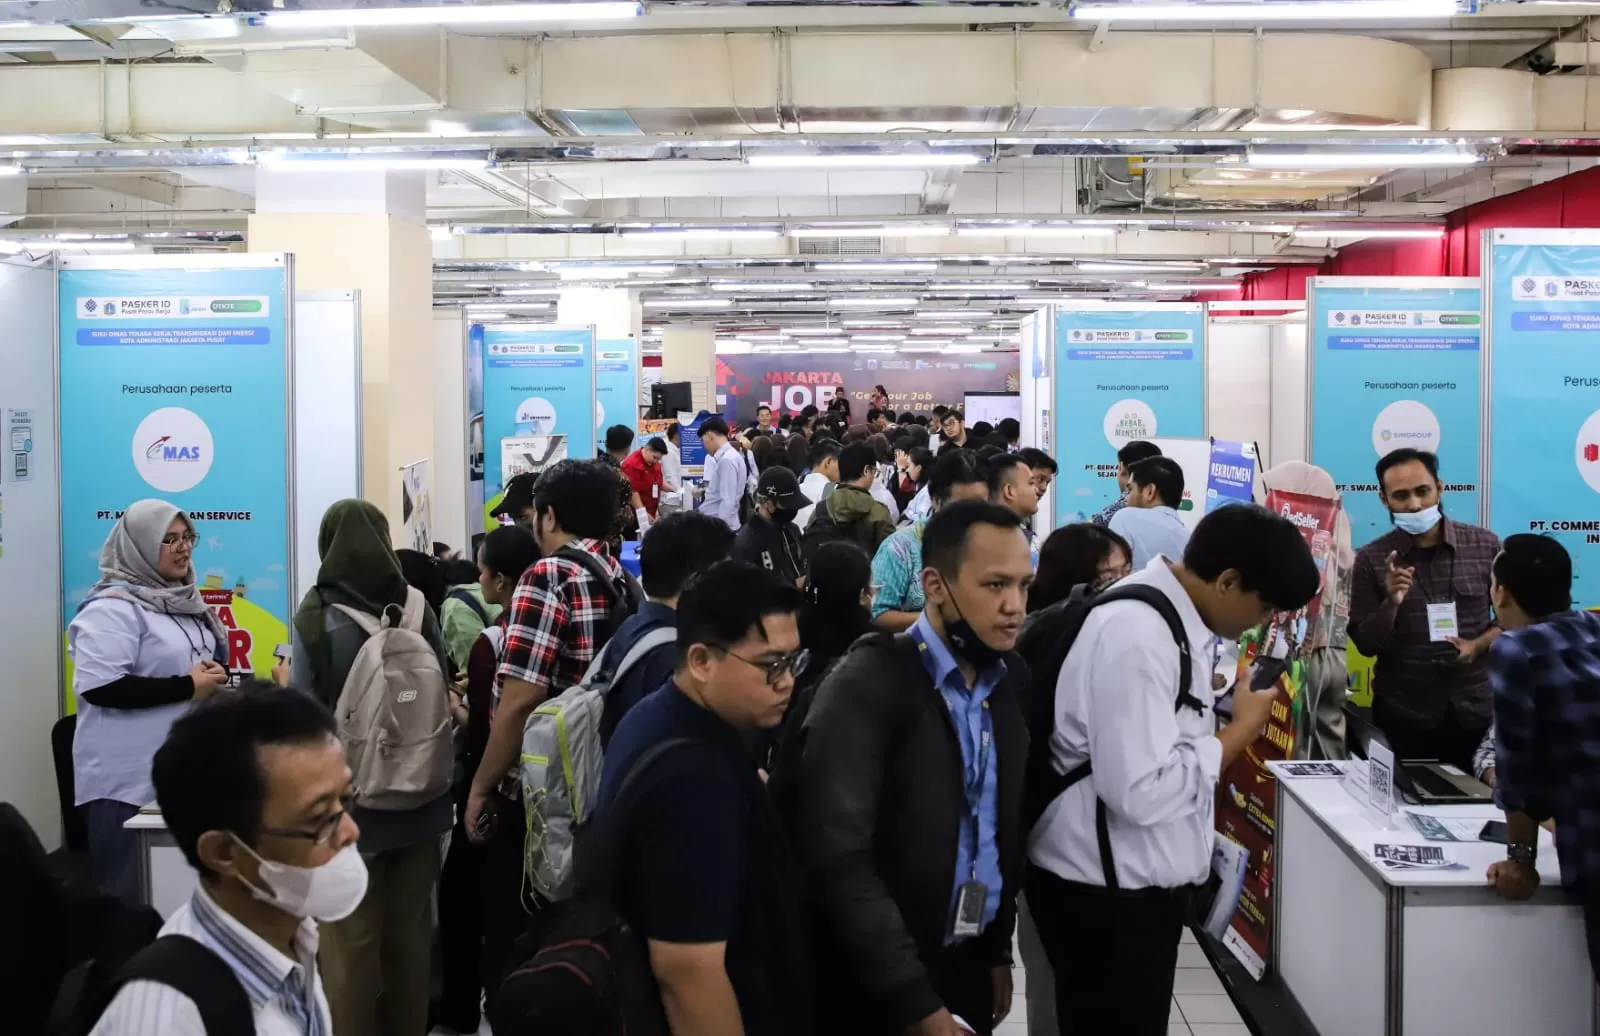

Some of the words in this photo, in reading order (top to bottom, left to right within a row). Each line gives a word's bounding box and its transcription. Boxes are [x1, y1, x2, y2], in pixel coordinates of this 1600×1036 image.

[121, 300, 159, 308] PASKER
[161, 300, 171, 308] ID
[760, 371, 844, 384] JAKARTA
[122, 384, 188, 394] Perusahaan
[190, 384, 232, 396] peserta
[1141, 384, 1169, 393] peserta
[1364, 381, 1420, 390] Perusahaan
[1421, 381, 1456, 391] peserta
[850, 391, 870, 400] "Ge
[887, 392, 908, 400] our
[910, 391, 932, 400] Job
[163, 446, 200, 459] MAS
[1210, 462, 1252, 483] REKRUTMEN
[1335, 484, 1349, 492] PT.
[1350, 484, 1379, 492] SWAK
[1443, 484, 1476, 492] ANDIRI
[97, 511, 114, 520] PT.
[206, 511, 251, 520] SERVICE
[1530, 521, 1549, 531] PT.
[1271, 700, 1288, 723] CUAN
[1266, 722, 1289, 750] JUTAAN
